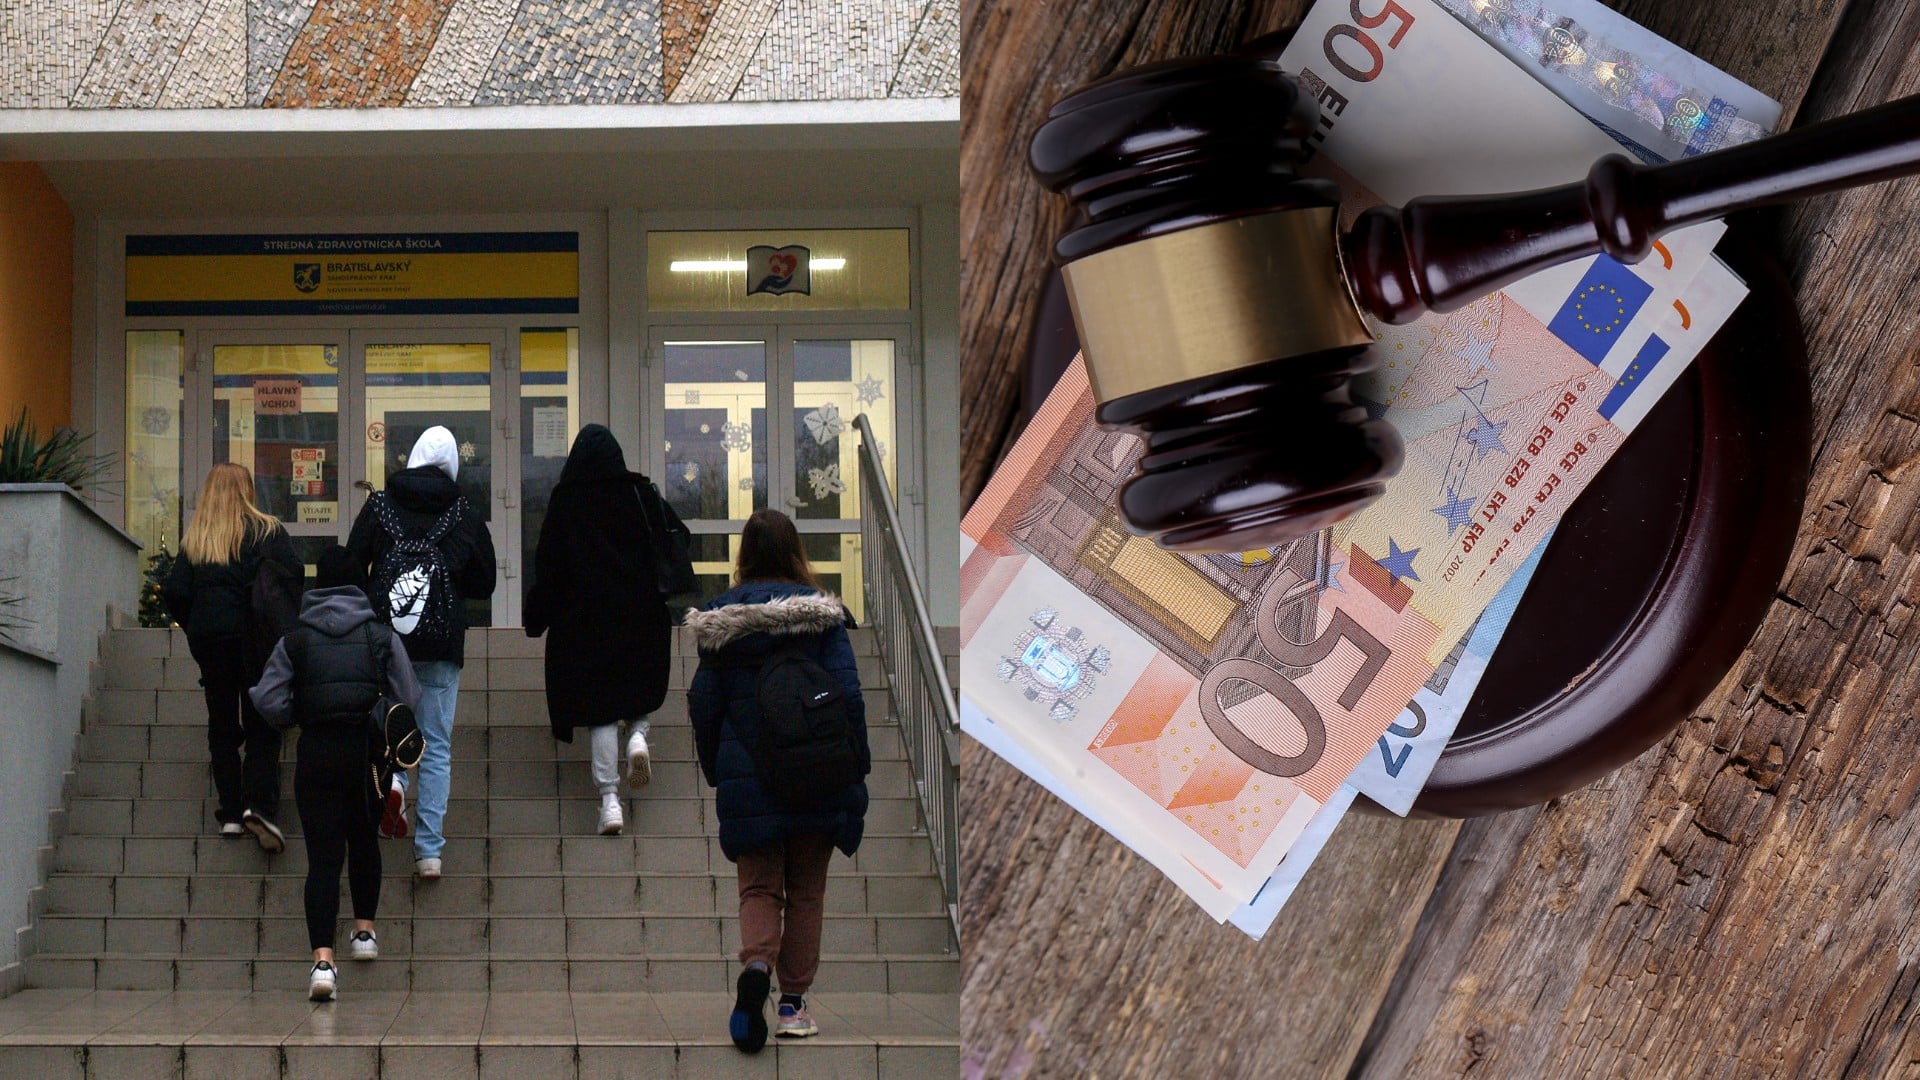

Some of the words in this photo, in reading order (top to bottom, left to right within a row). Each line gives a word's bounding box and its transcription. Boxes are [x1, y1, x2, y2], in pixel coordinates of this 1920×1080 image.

[1322, 0, 1416, 82] 50
[263, 239, 313, 250] STREDNÁ
[317, 239, 402, 249] ZDRAVOTNÍCKA
[405, 237, 441, 249] ŠKOLA
[326, 259, 412, 272] BRATISLAVSKÝ
[257, 385, 298, 395] HLAVNÝ
[261, 400, 296, 408] VCHOD
[1550, 391, 1577, 423] BCE
[1526, 424, 1554, 457] ECB
[1559, 441, 1587, 472] BCE
[1504, 457, 1530, 489] EZB
[1480, 491, 1507, 523] EKT
[1458, 522, 1485, 554] EKP
[1441, 554, 1464, 583] 2002
[1200, 567, 1392, 779] 50
